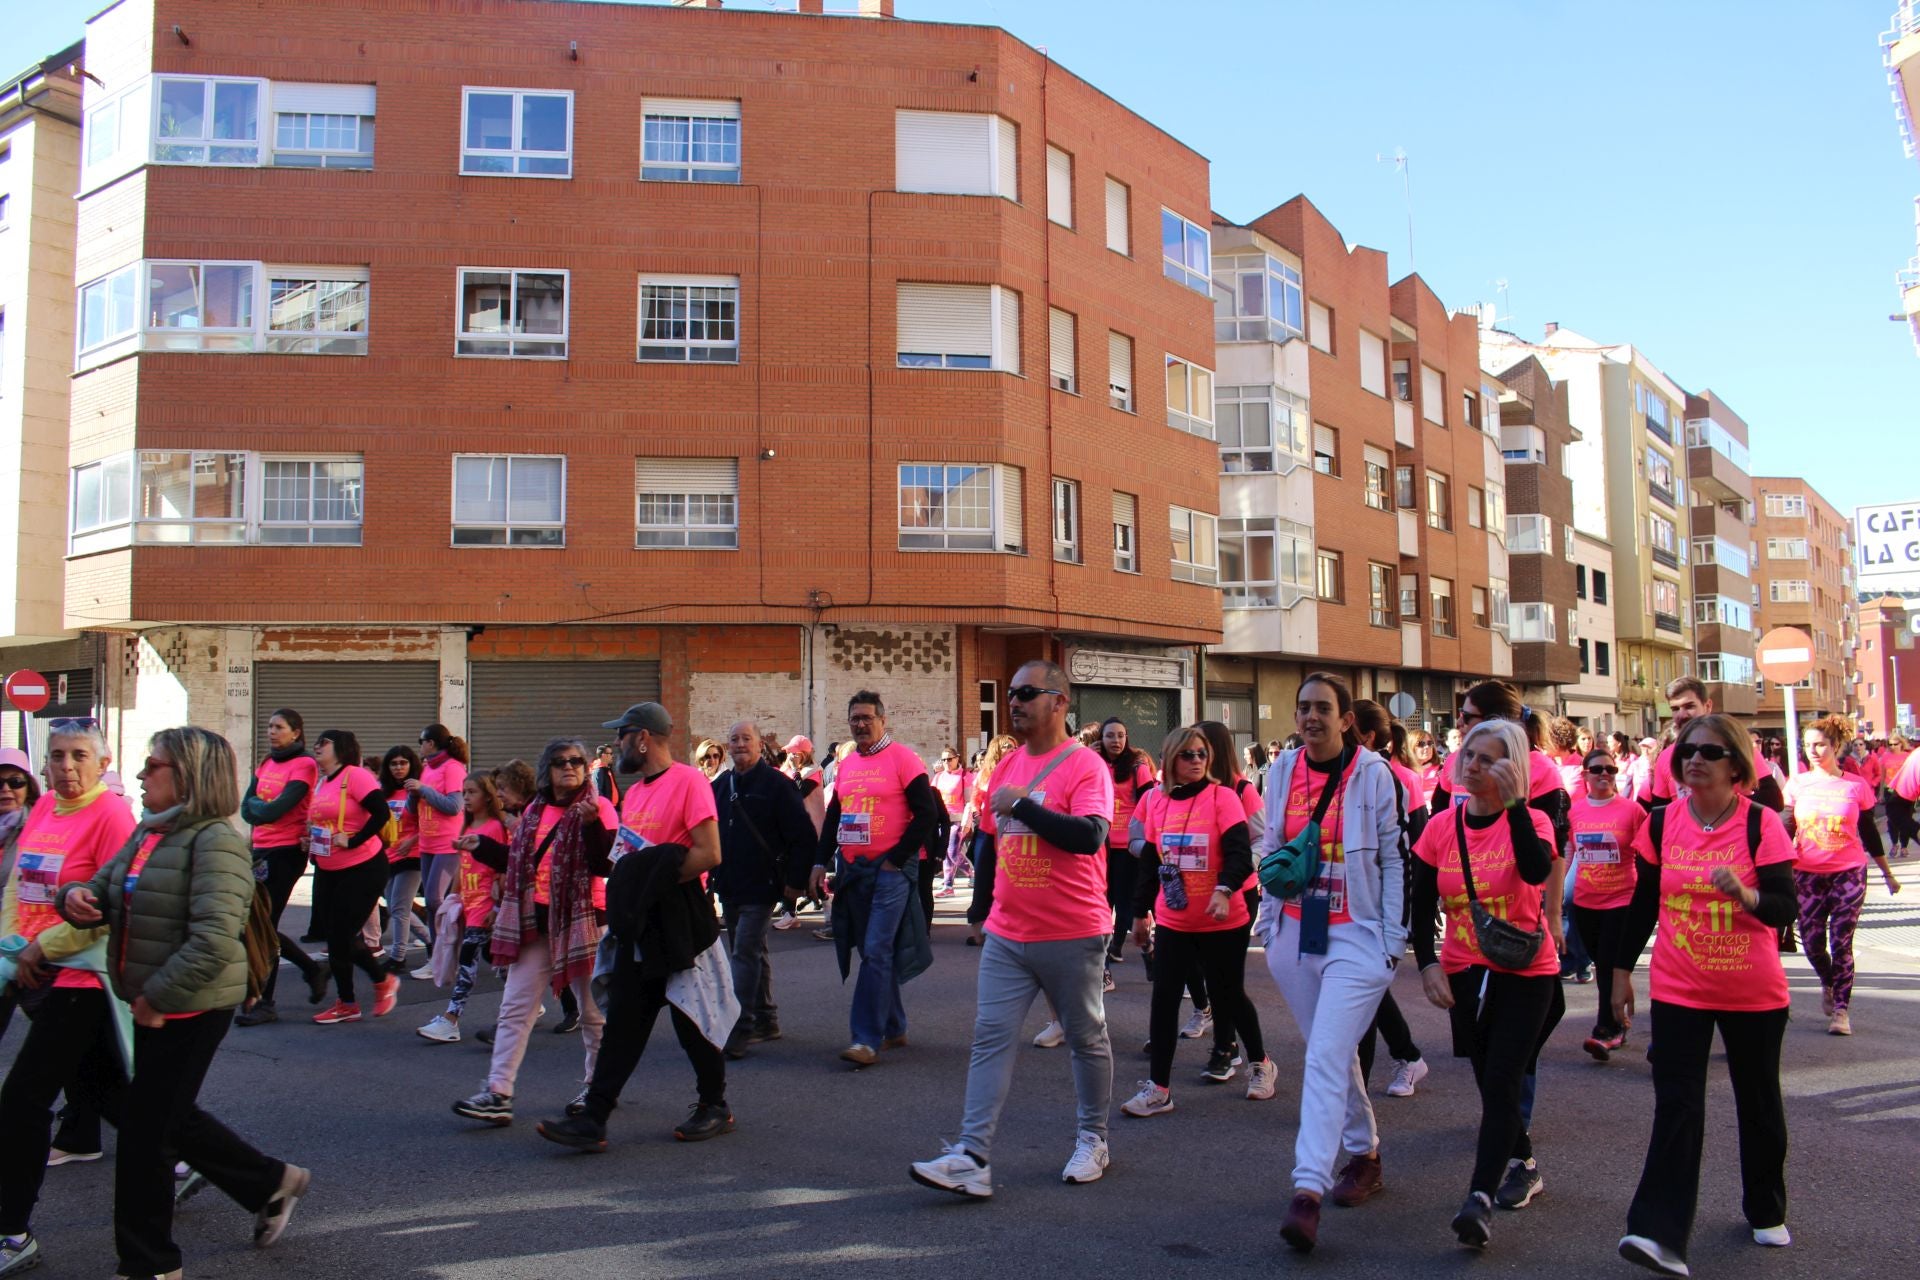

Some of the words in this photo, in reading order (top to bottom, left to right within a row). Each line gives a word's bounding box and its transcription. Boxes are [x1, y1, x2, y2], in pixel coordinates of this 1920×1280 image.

[1867, 509, 1920, 533] CAF
[1863, 544, 1894, 565] LA
[228, 665, 250, 673] ALQUILA
[1008, 854, 1052, 868] Carrera
[1692, 931, 1751, 946] Carrera
[1708, 945, 1751, 958] Mujer
